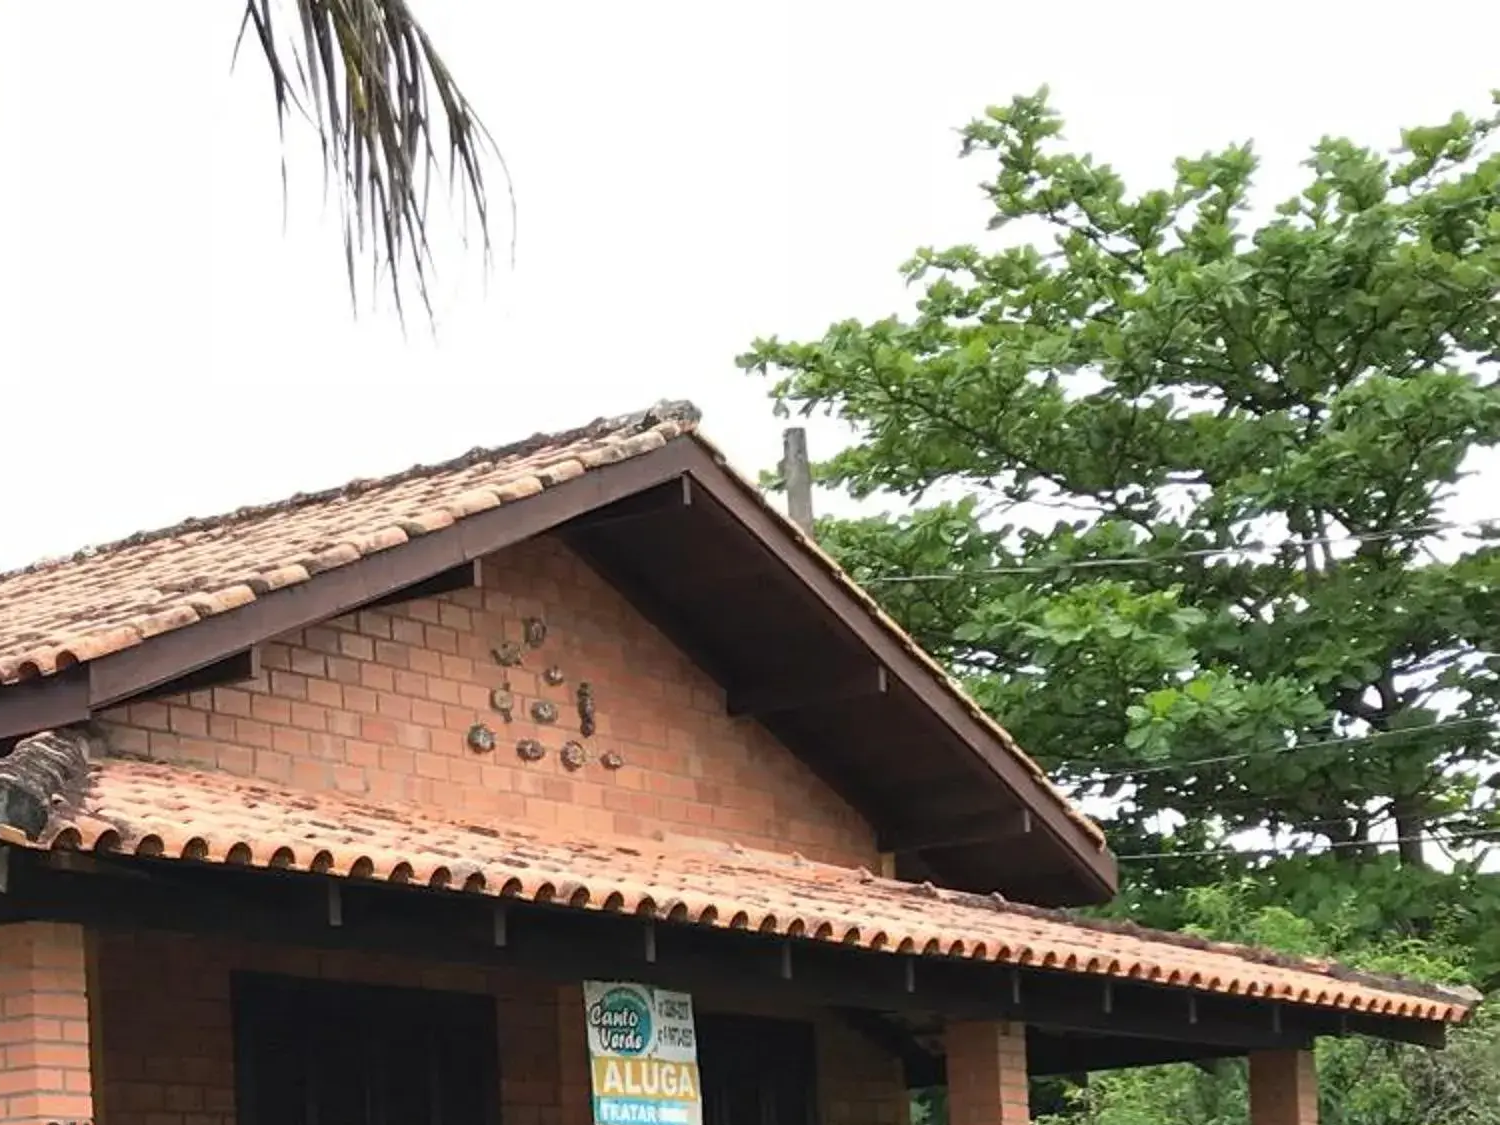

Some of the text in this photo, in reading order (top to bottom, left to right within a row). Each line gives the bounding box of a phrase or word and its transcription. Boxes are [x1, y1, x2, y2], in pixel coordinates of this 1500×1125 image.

[590, 1003, 639, 1027] Canto
[600, 1027, 643, 1049] Verde
[603, 1059, 695, 1098] ALUGA
[602, 1102, 657, 1123] TRATAR
